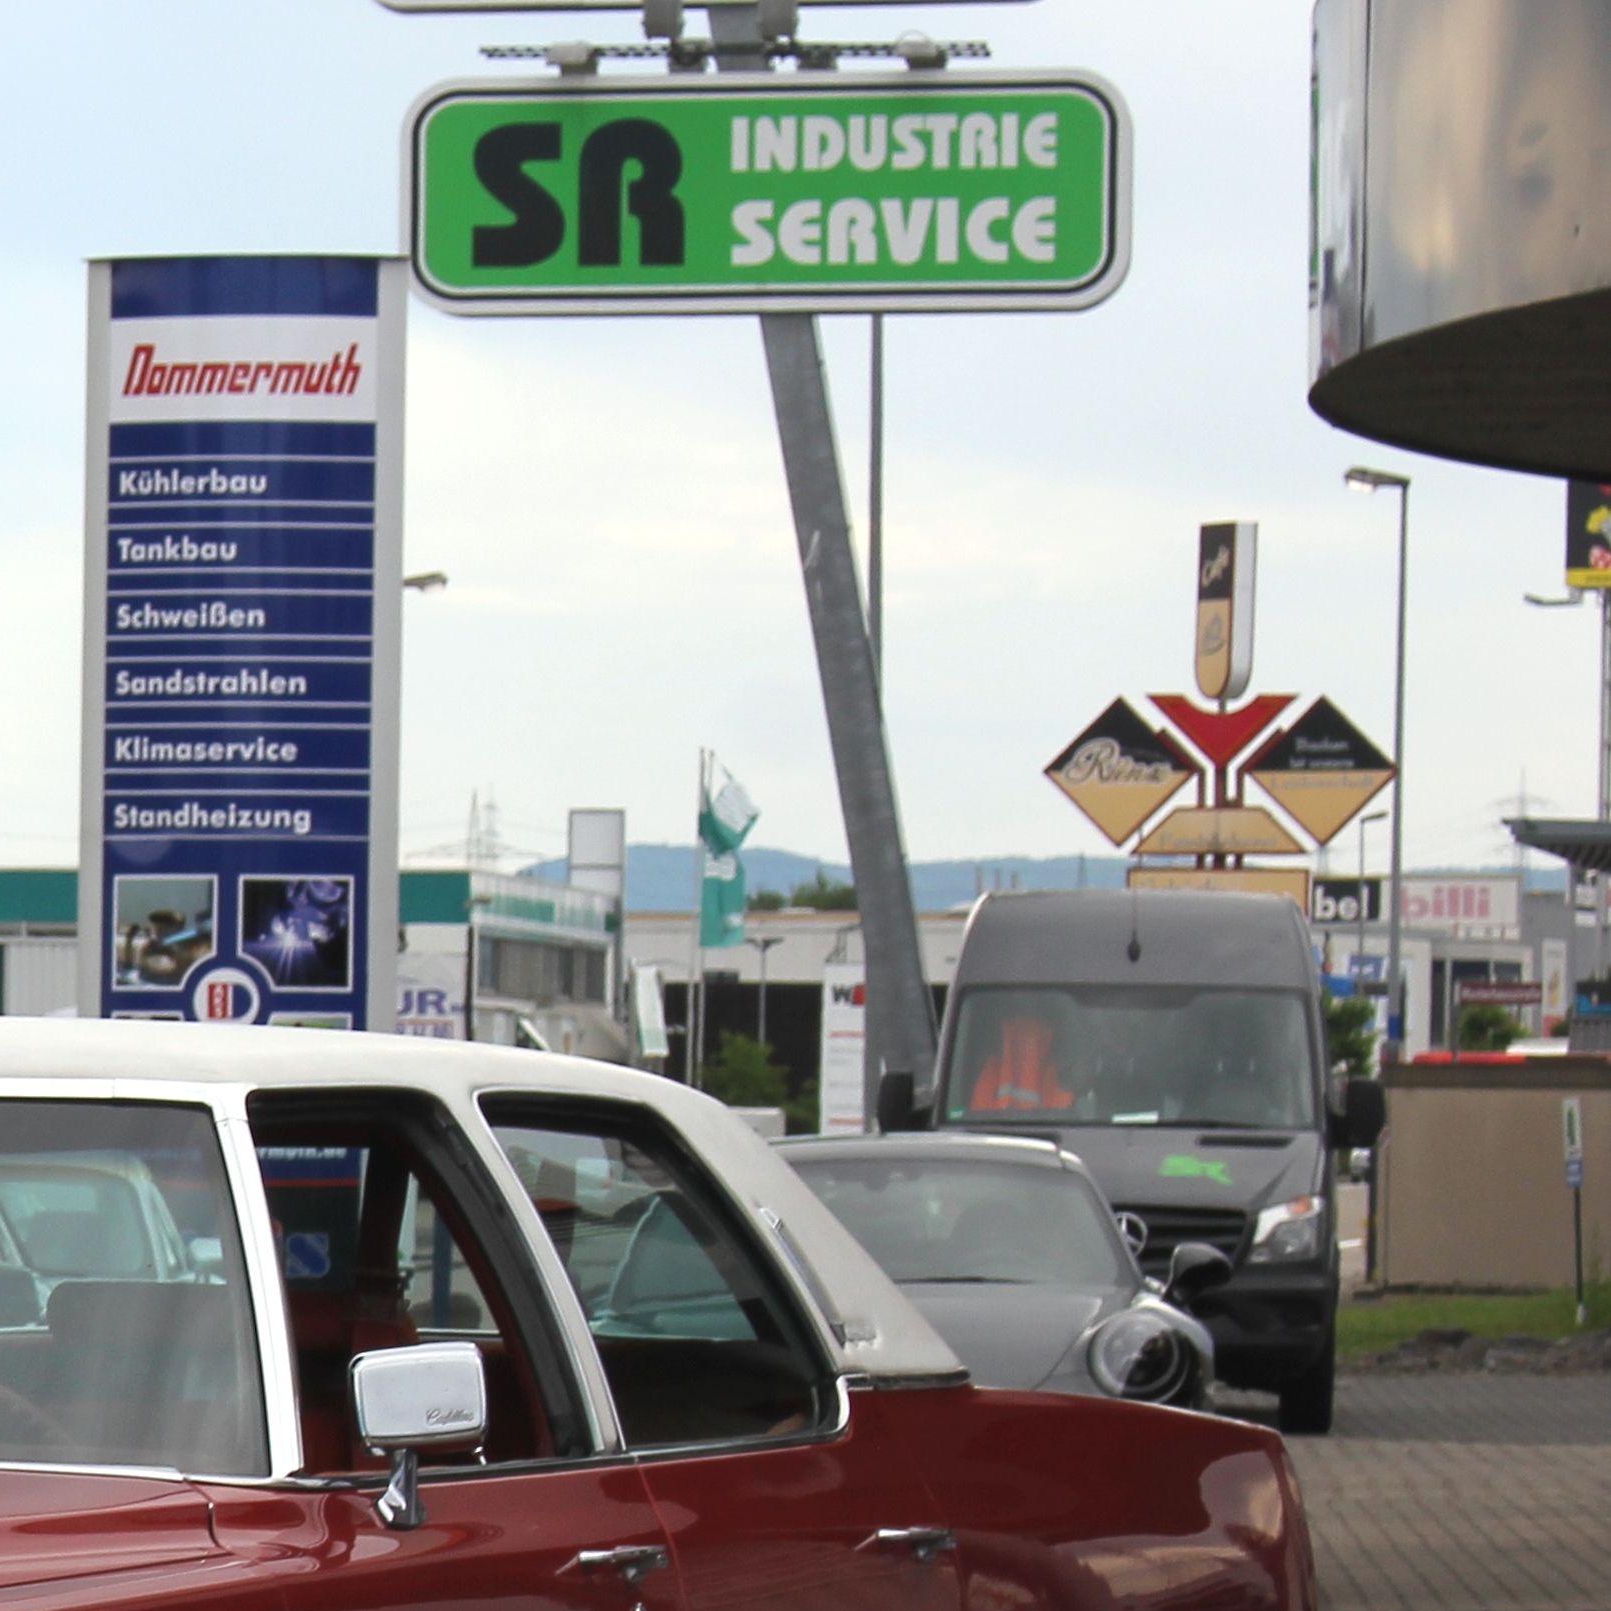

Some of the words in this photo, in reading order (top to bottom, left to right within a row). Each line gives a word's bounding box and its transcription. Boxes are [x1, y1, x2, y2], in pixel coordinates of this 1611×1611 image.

[731, 113, 1058, 172] INDUSTRIE
[472, 118, 685, 268] SR
[731, 197, 1056, 265] SERVICE
[119, 468, 267, 495] Kühlerbau
[117, 536, 238, 562] Tankbau
[116, 602, 265, 628] Schweißen
[115, 670, 308, 695] Sandstrahlen
[114, 737, 299, 761] Klimaservice
[114, 803, 312, 834] Standheizung
